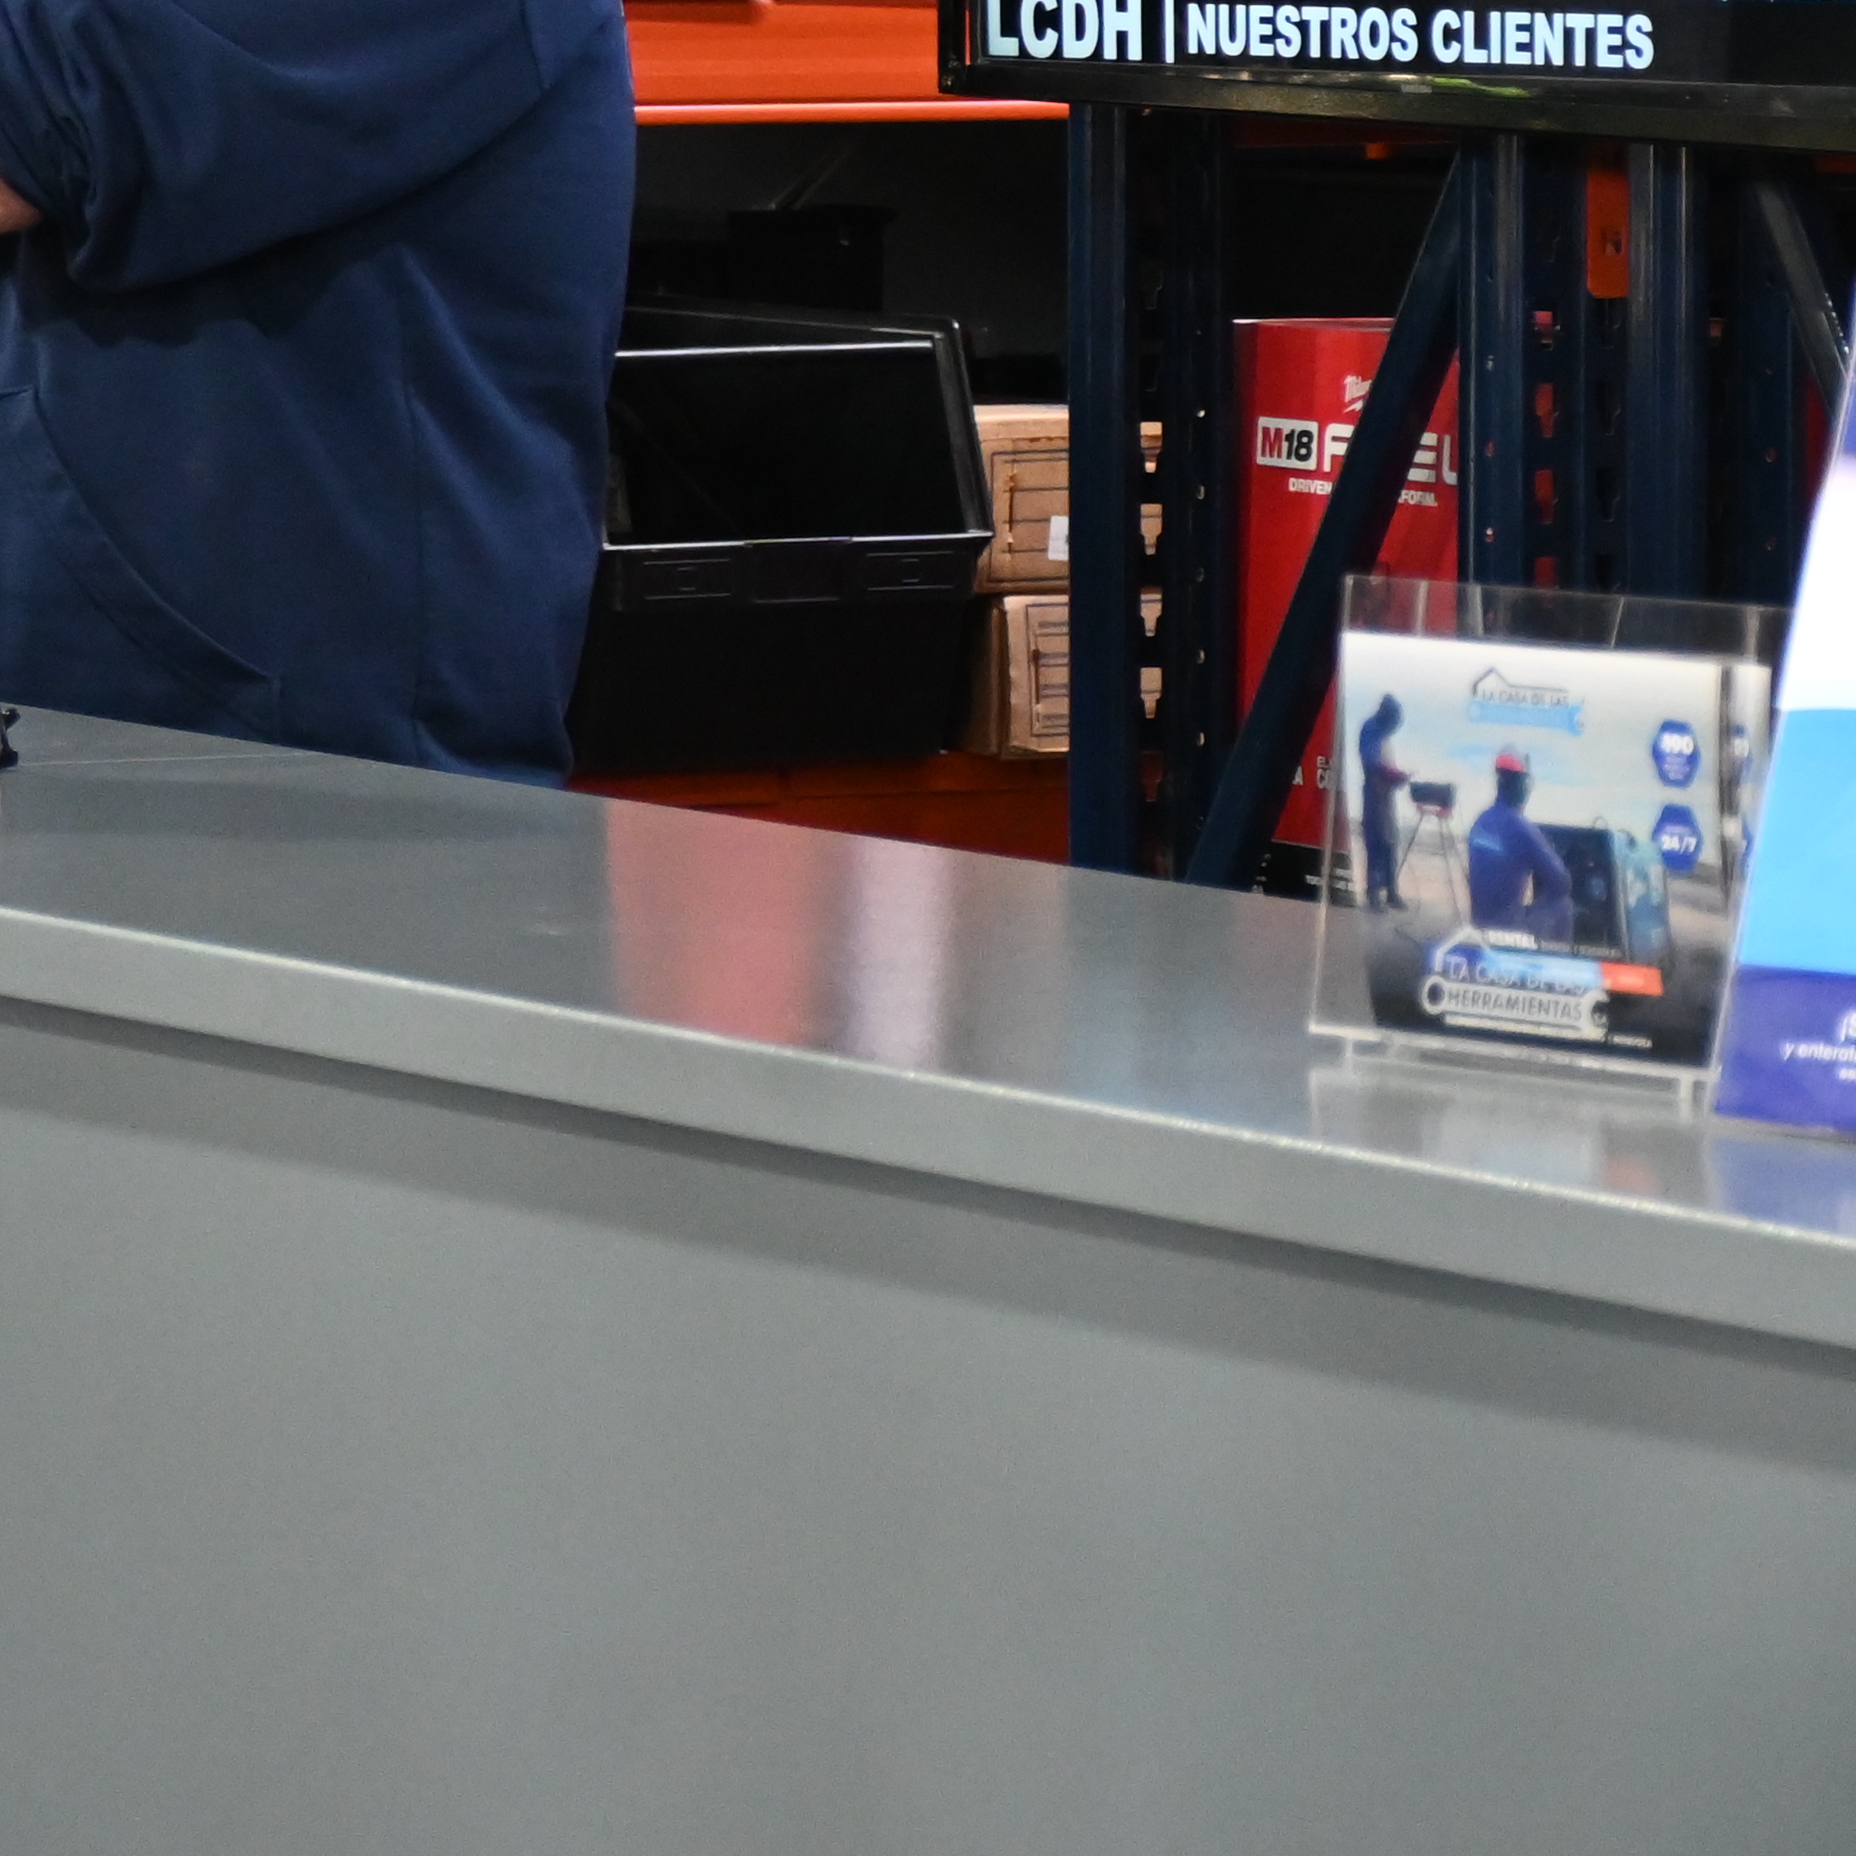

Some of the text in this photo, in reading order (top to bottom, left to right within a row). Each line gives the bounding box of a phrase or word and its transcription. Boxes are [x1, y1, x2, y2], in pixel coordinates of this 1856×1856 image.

[1187, 2, 1419, 62] NUESTROS
[1431, 8, 1655, 70] CLIENTES
[1260, 422, 1459, 486] M18 FEL
[1661, 834, 1698, 855] 24/7
[1447, 989, 1583, 1024] HERRAMIENTAS
